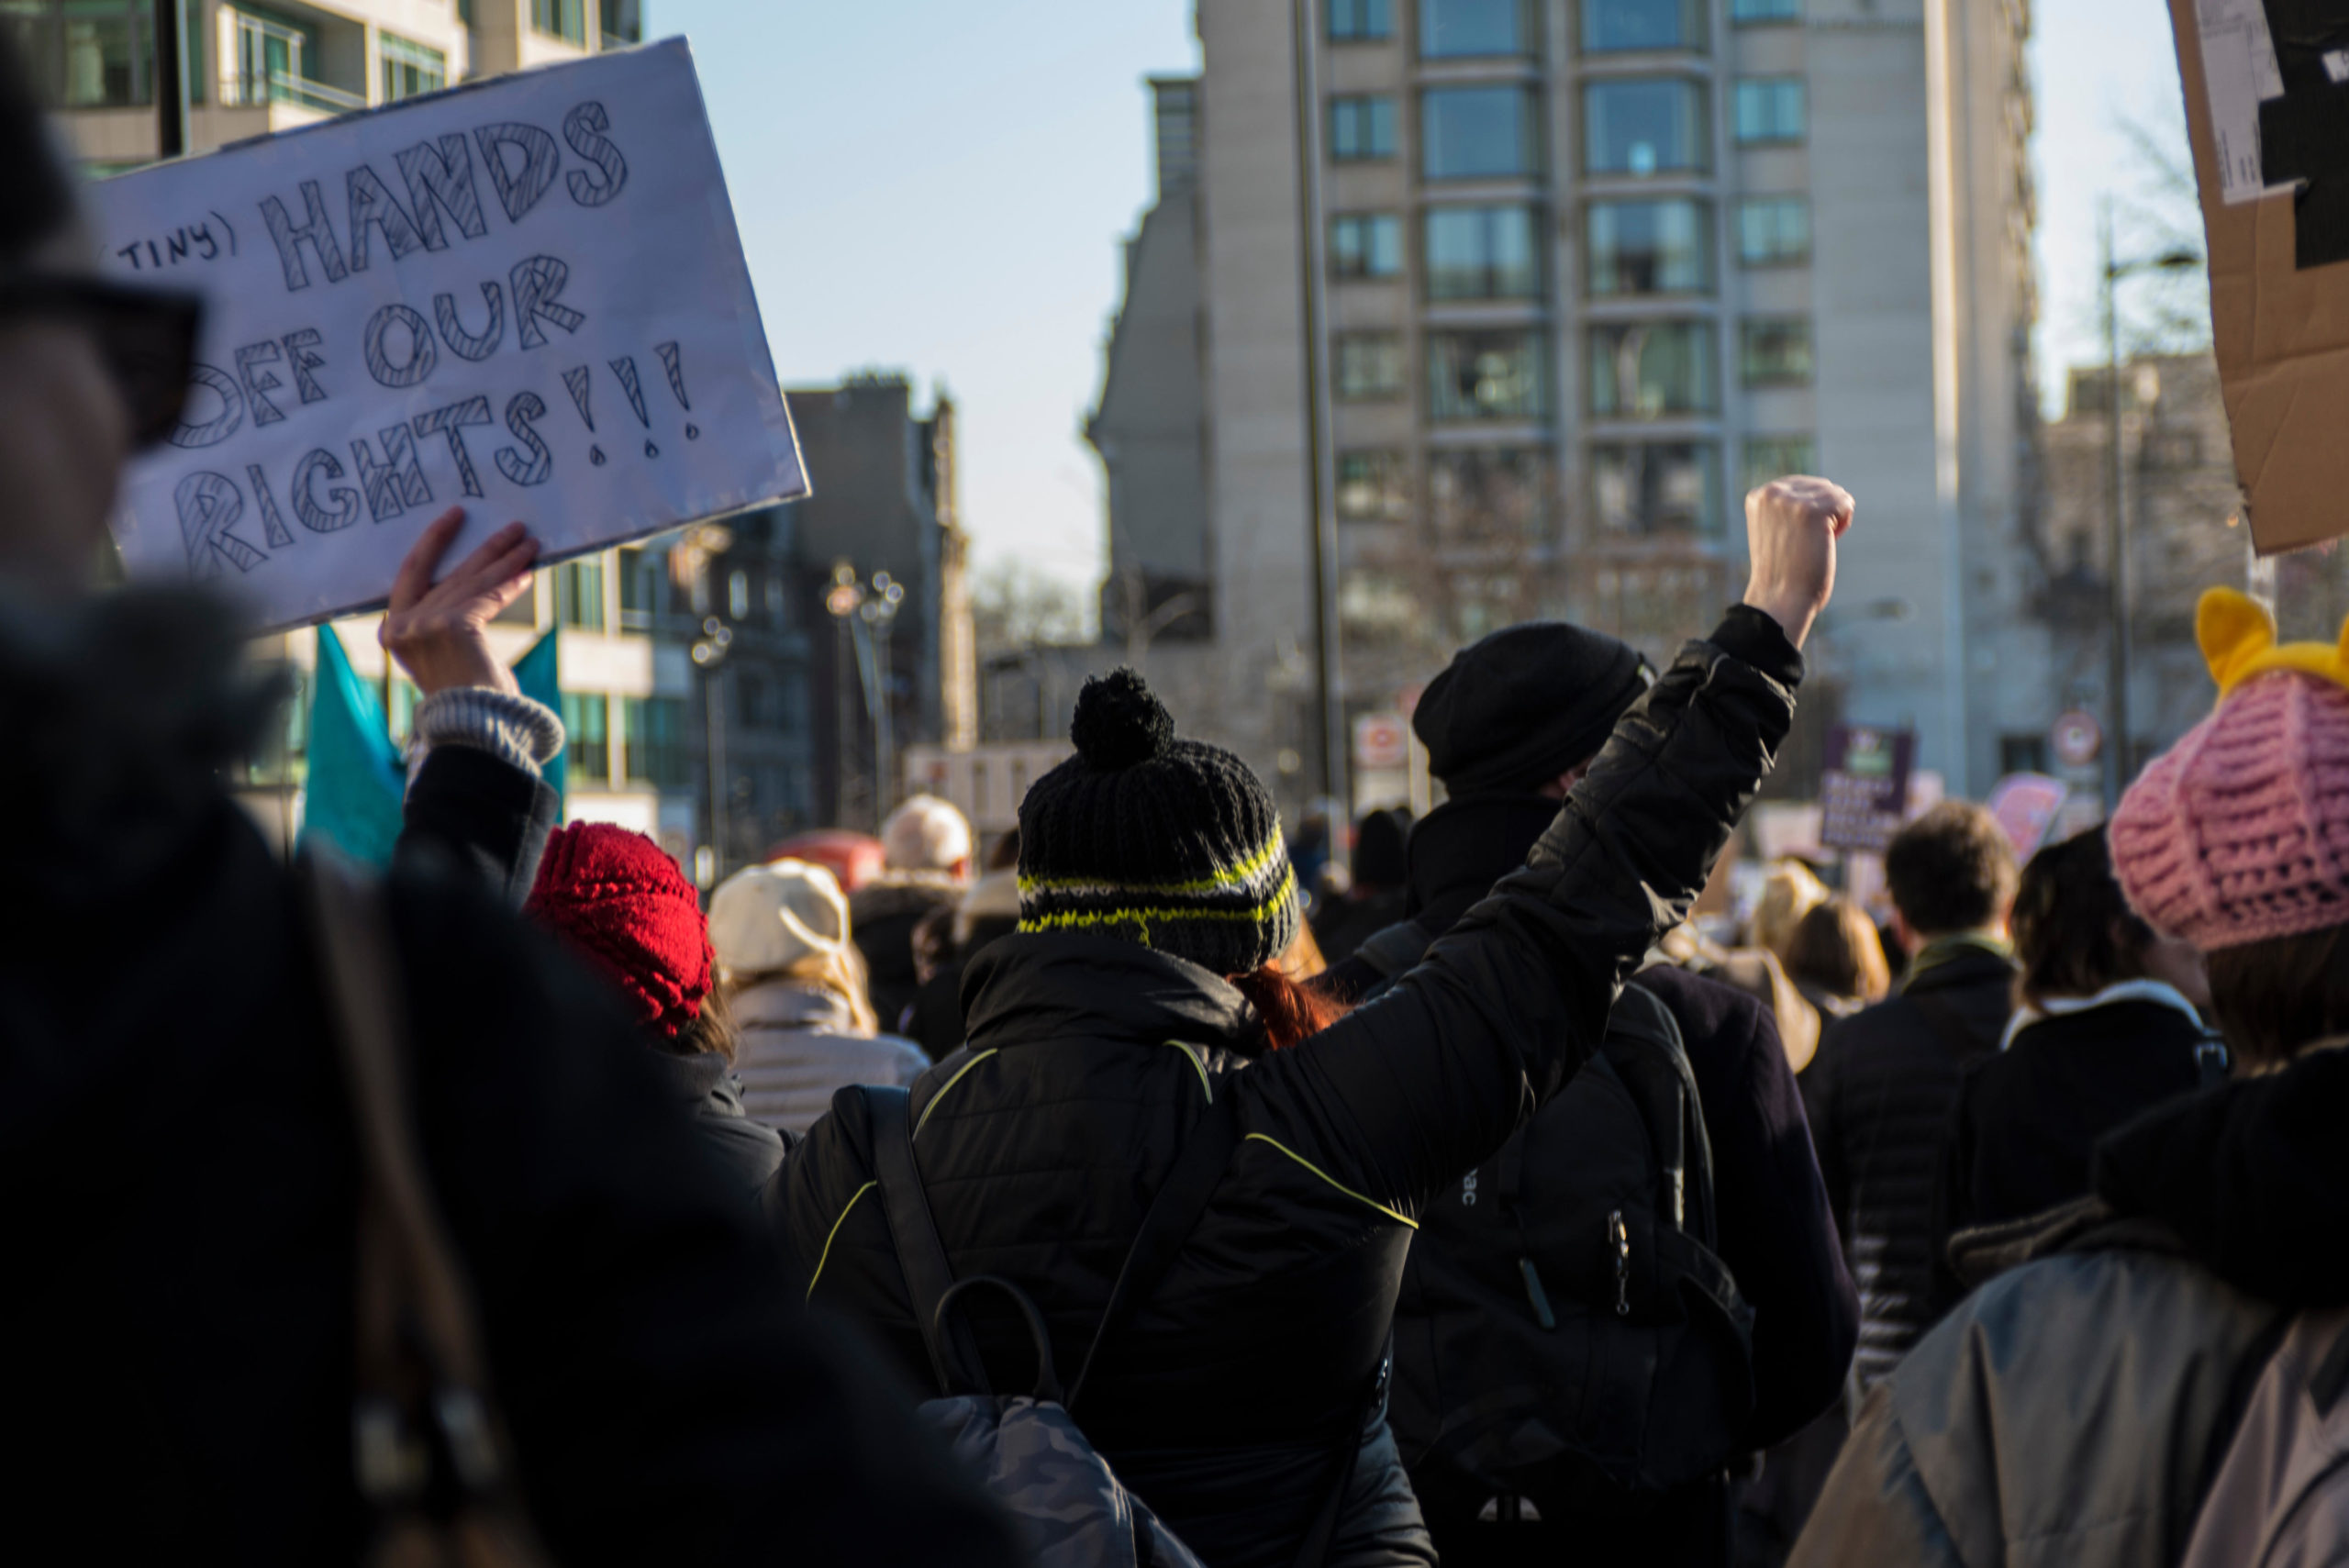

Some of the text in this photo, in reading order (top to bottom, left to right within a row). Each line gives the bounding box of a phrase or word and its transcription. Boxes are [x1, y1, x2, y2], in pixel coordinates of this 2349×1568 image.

[259, 100, 629, 292] HANDS
[167, 253, 585, 450] OFF OUR
[173, 340, 699, 578] RIGHTS!!!
[1463, 1167, 1478, 1207] ac
